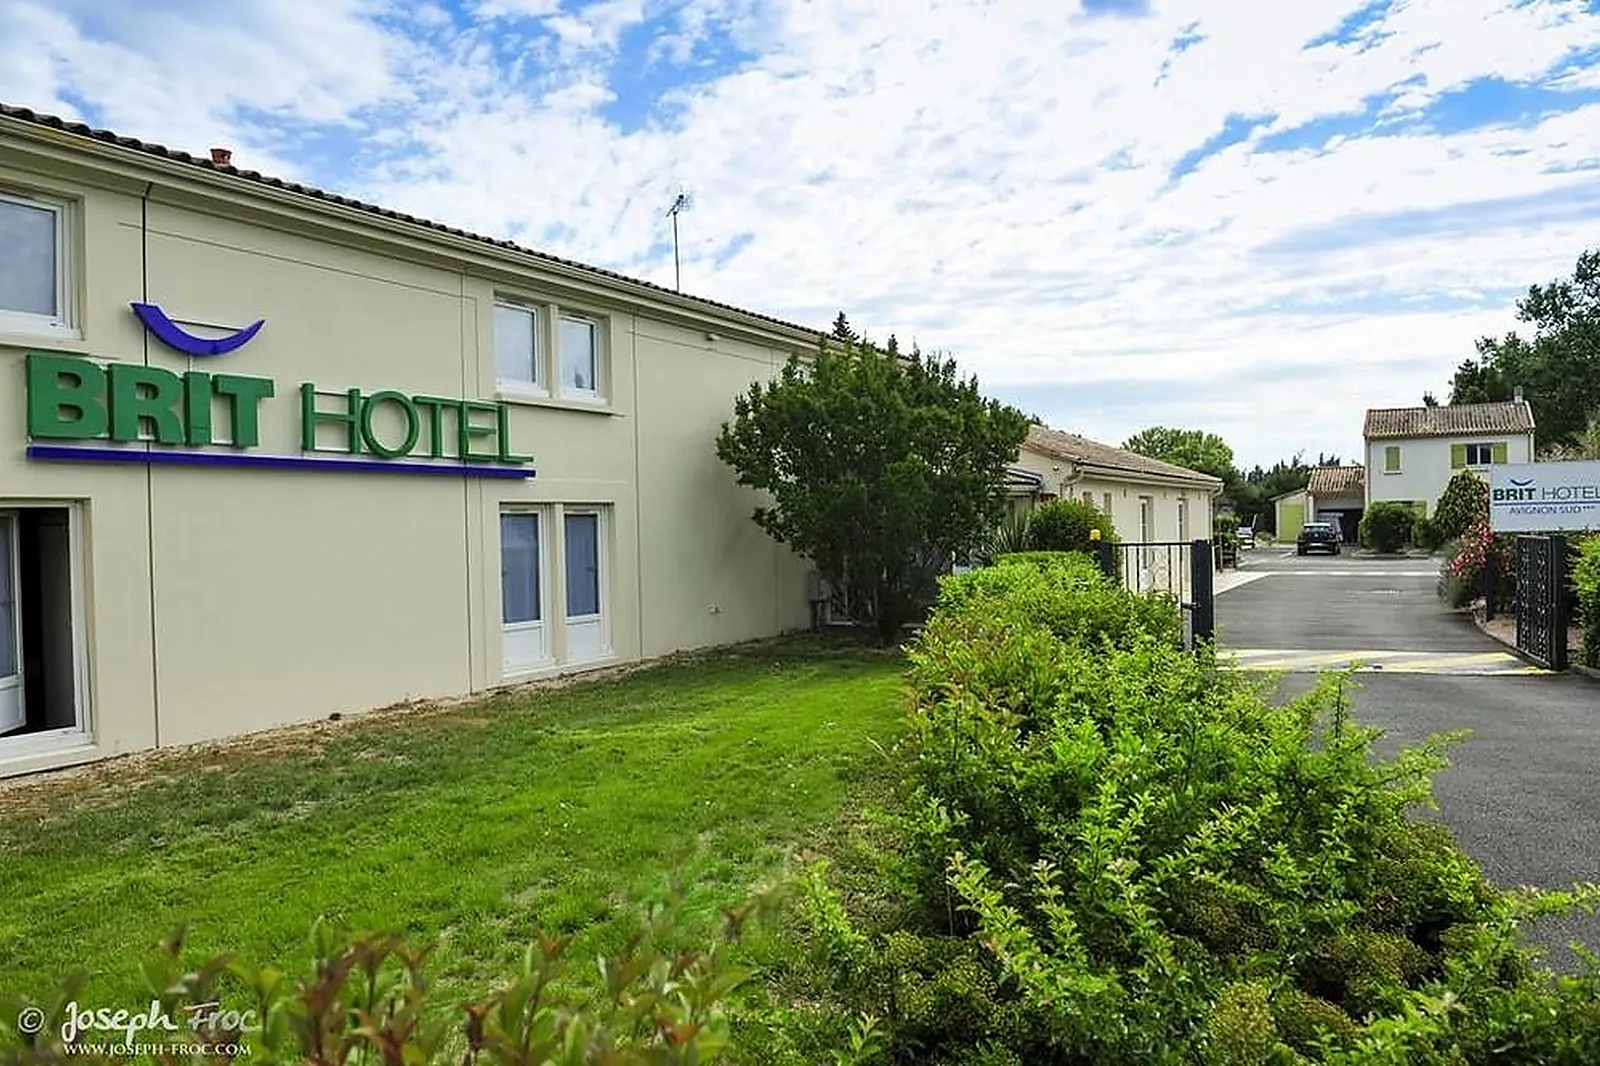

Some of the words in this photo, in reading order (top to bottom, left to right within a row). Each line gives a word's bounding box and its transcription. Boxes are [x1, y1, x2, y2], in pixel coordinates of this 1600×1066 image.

[26, 353, 275, 448] BRIT
[300, 382, 534, 465] HOTEL
[1493, 488, 1536, 501] BRIT
[1542, 486, 1600, 500] HOTEL
[1510, 506, 1557, 514] AVIGNON
[1559, 505, 1581, 513] SUD
